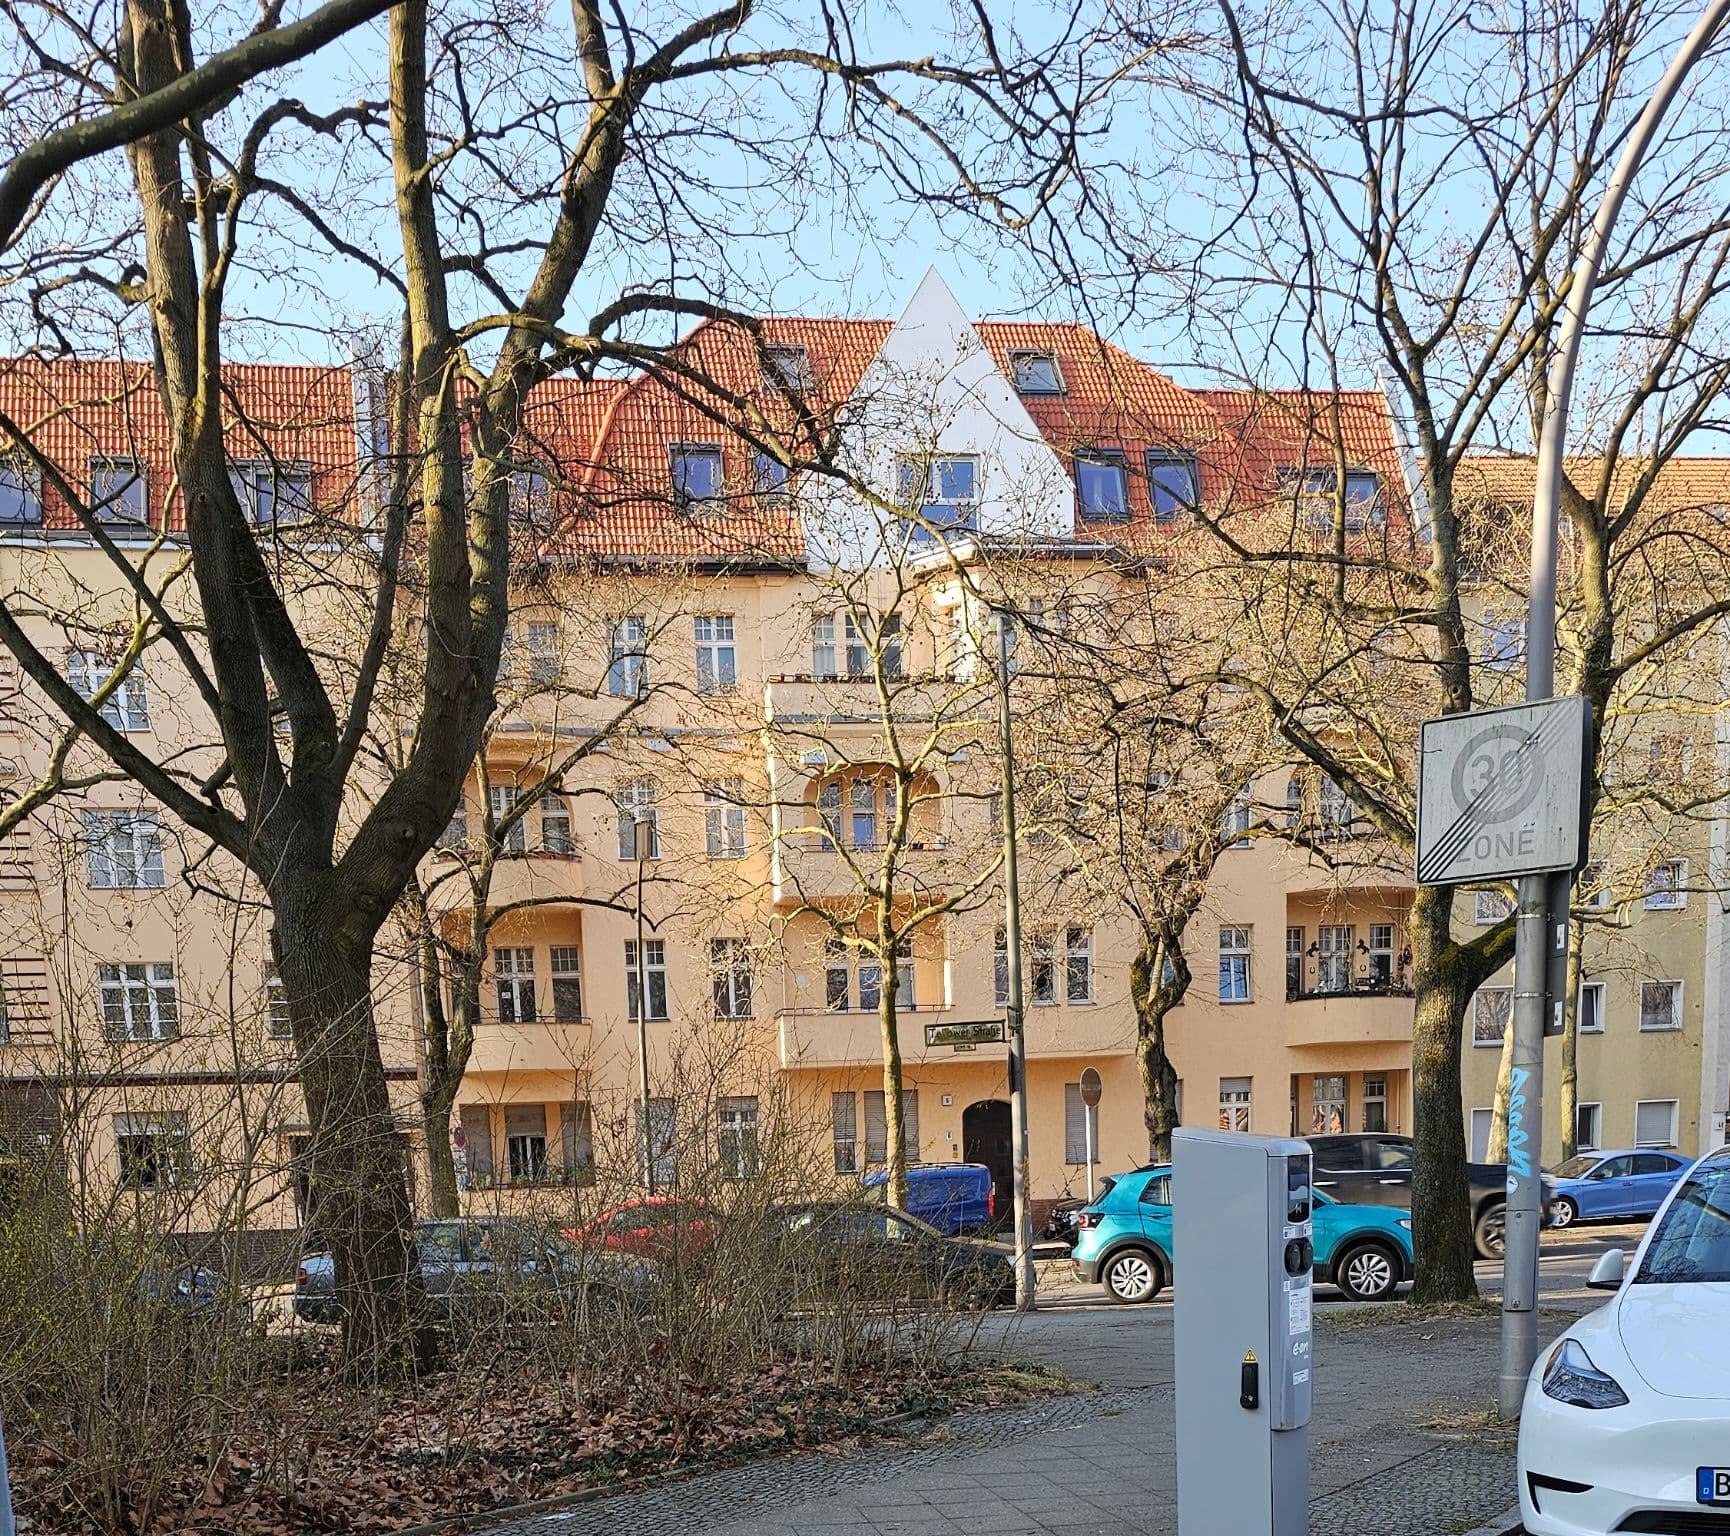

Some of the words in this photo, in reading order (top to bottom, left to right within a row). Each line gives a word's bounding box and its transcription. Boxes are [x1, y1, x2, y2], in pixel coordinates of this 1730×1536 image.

[1470, 751, 1522, 800] 30
[928, 1027, 969, 1038] Telower
[973, 1025, 1001, 1037] Straße
